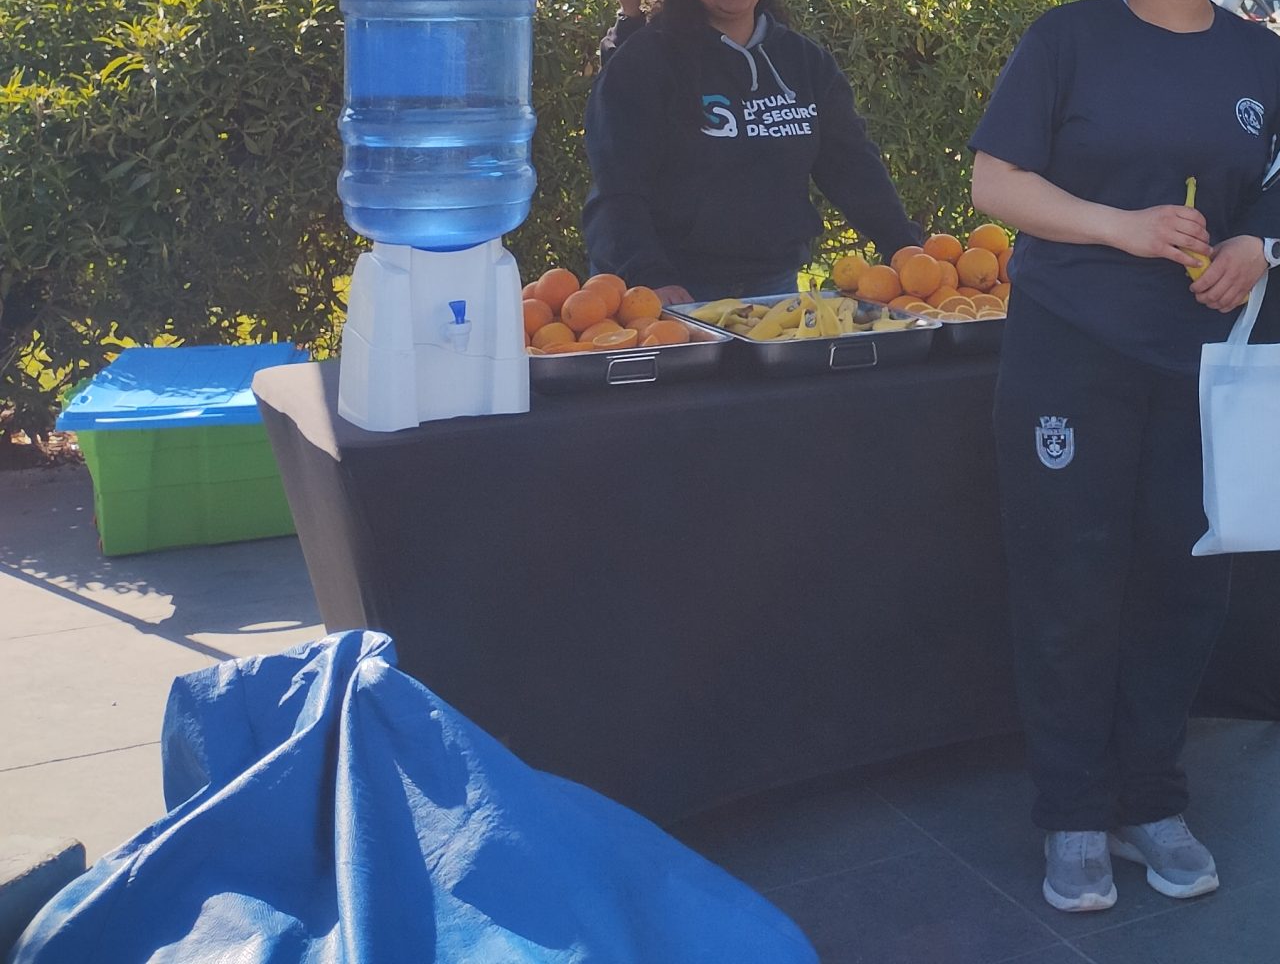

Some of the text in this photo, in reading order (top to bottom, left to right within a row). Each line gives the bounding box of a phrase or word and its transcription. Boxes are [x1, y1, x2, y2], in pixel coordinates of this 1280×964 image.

[742, 94, 796, 112] UTUAL
[747, 122, 812, 137] DE CHILE
